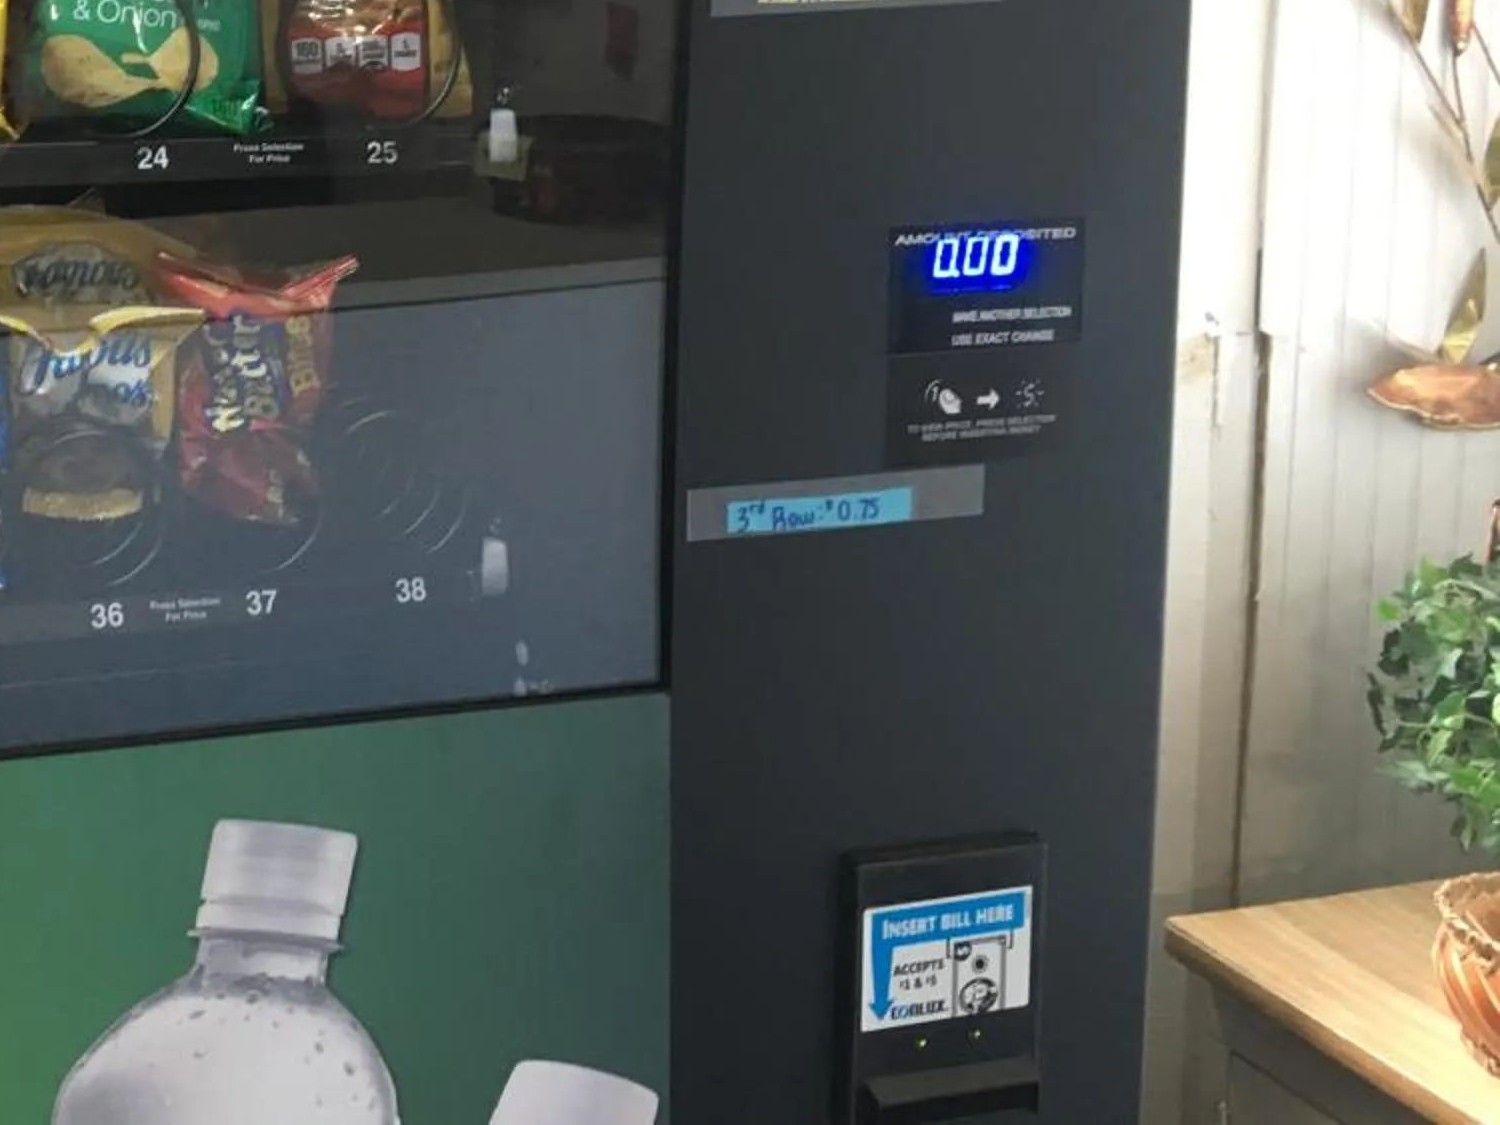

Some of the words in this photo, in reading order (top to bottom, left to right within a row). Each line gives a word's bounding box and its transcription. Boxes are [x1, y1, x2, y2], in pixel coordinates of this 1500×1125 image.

[137, 145, 170, 170] 24
[367, 140, 399, 165] 25
[246, 589, 278, 616] 37
[395, 576, 427, 604] 38
[91, 601, 124, 630] 36
[881, 914, 937, 940] INSERT
[940, 910, 971, 931] BILL
[975, 903, 1014, 925] HERE
[894, 958, 945, 977] ACCEPTS
